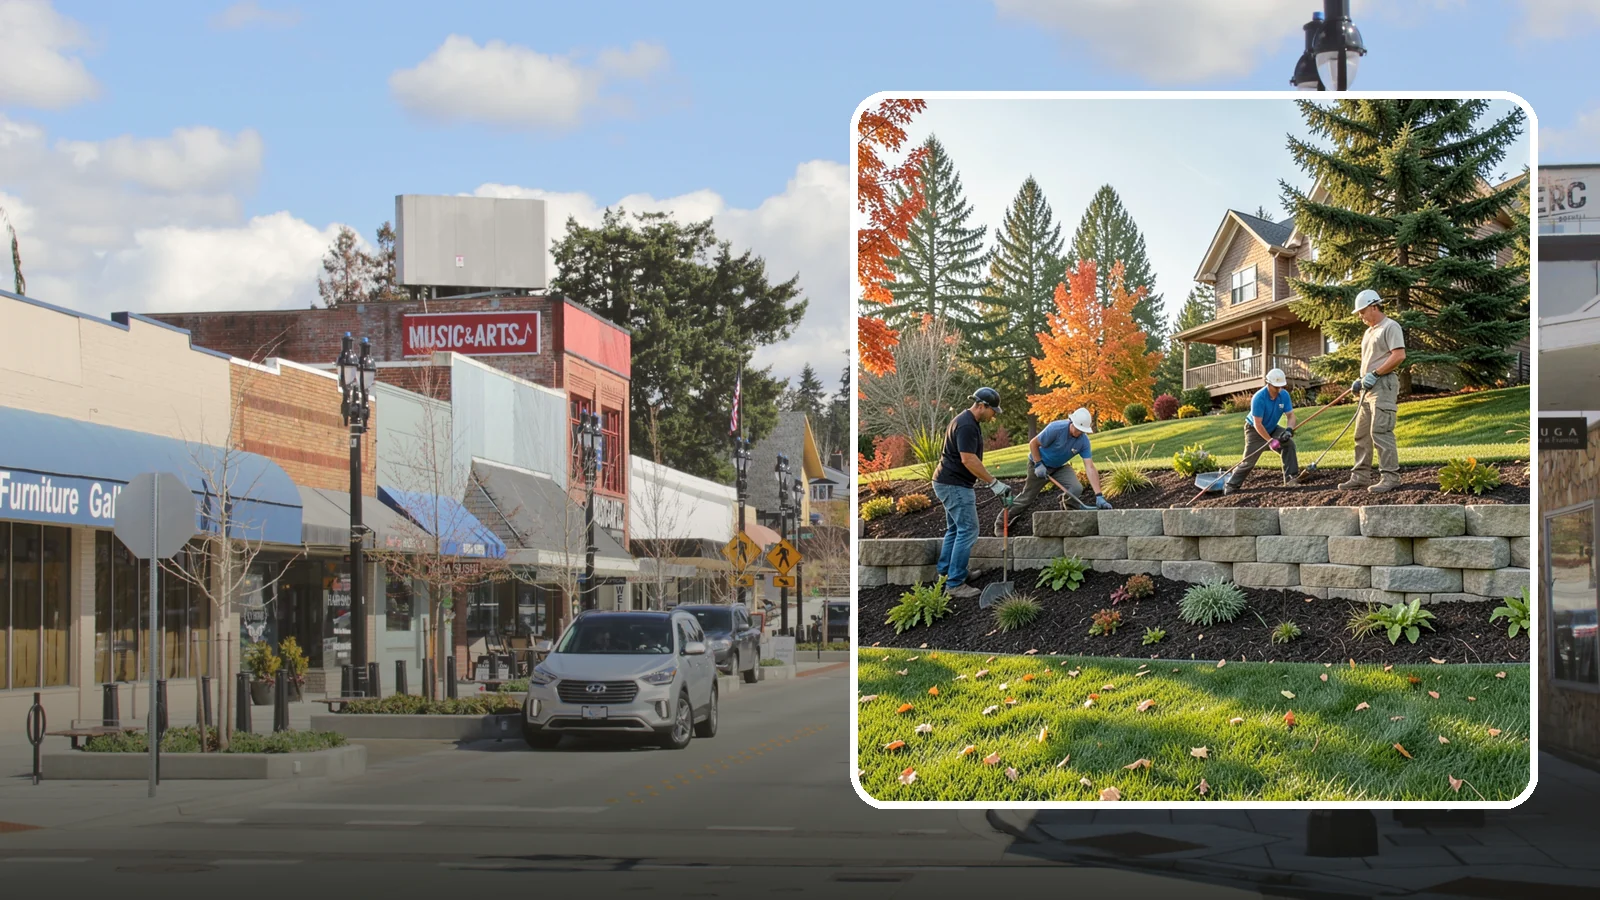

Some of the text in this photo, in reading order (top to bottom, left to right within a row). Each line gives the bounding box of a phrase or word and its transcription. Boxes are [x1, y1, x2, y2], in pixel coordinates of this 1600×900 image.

[408, 322, 520, 349] MUSIC&ARTS
[1540, 427, 1577, 437] UGA
[0, 471, 122, 519] Furniture Gal
[453, 563, 480, 574] SUSHI
